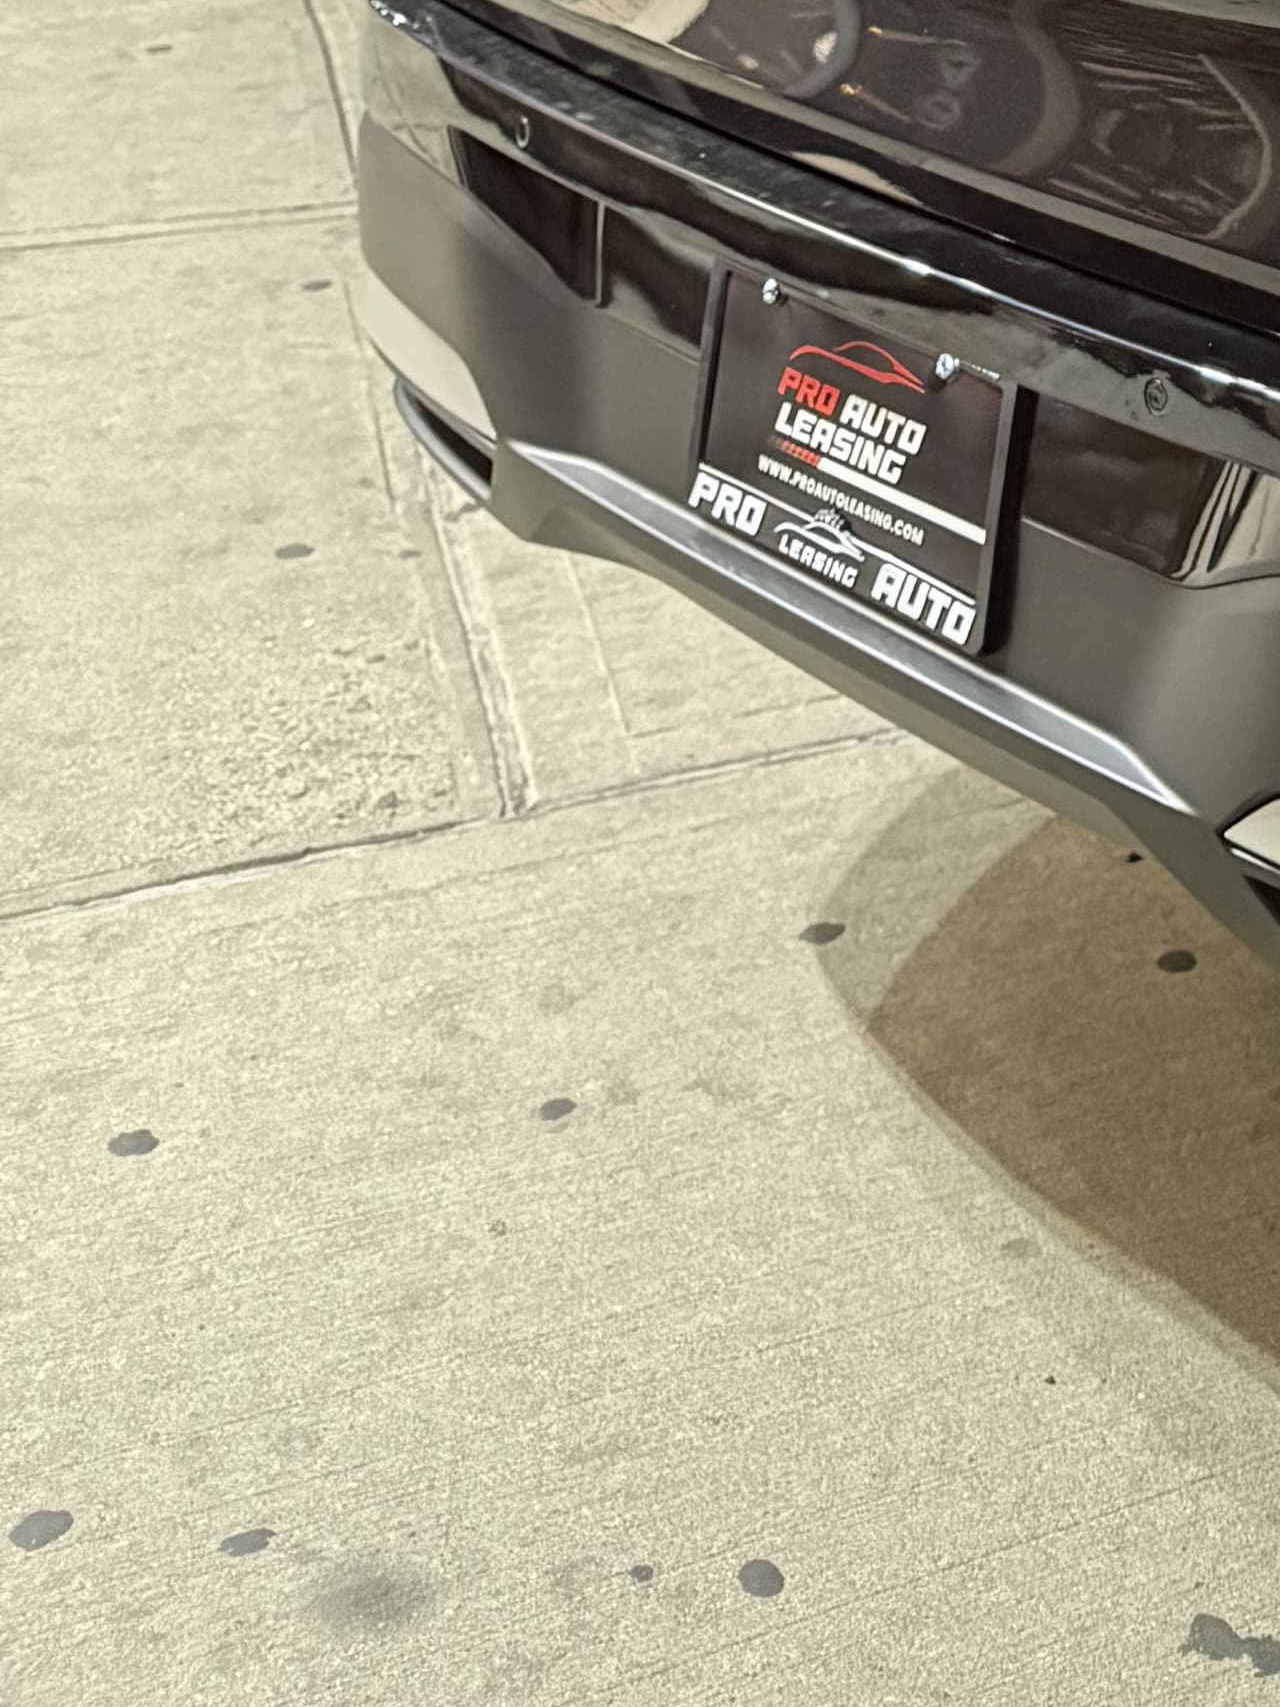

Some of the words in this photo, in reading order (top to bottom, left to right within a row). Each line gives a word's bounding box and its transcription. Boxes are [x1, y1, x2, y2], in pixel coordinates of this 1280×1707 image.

[775, 402, 907, 484] LEASING
[777, 366, 840, 416] PRO
[839, 394, 926, 456] AUTO
[757, 454, 926, 546] WWW.PROAUTOLEASING.COM
[688, 471, 768, 537] PRO
[871, 563, 976, 646] AUTO
[778, 534, 859, 588] LEASING
